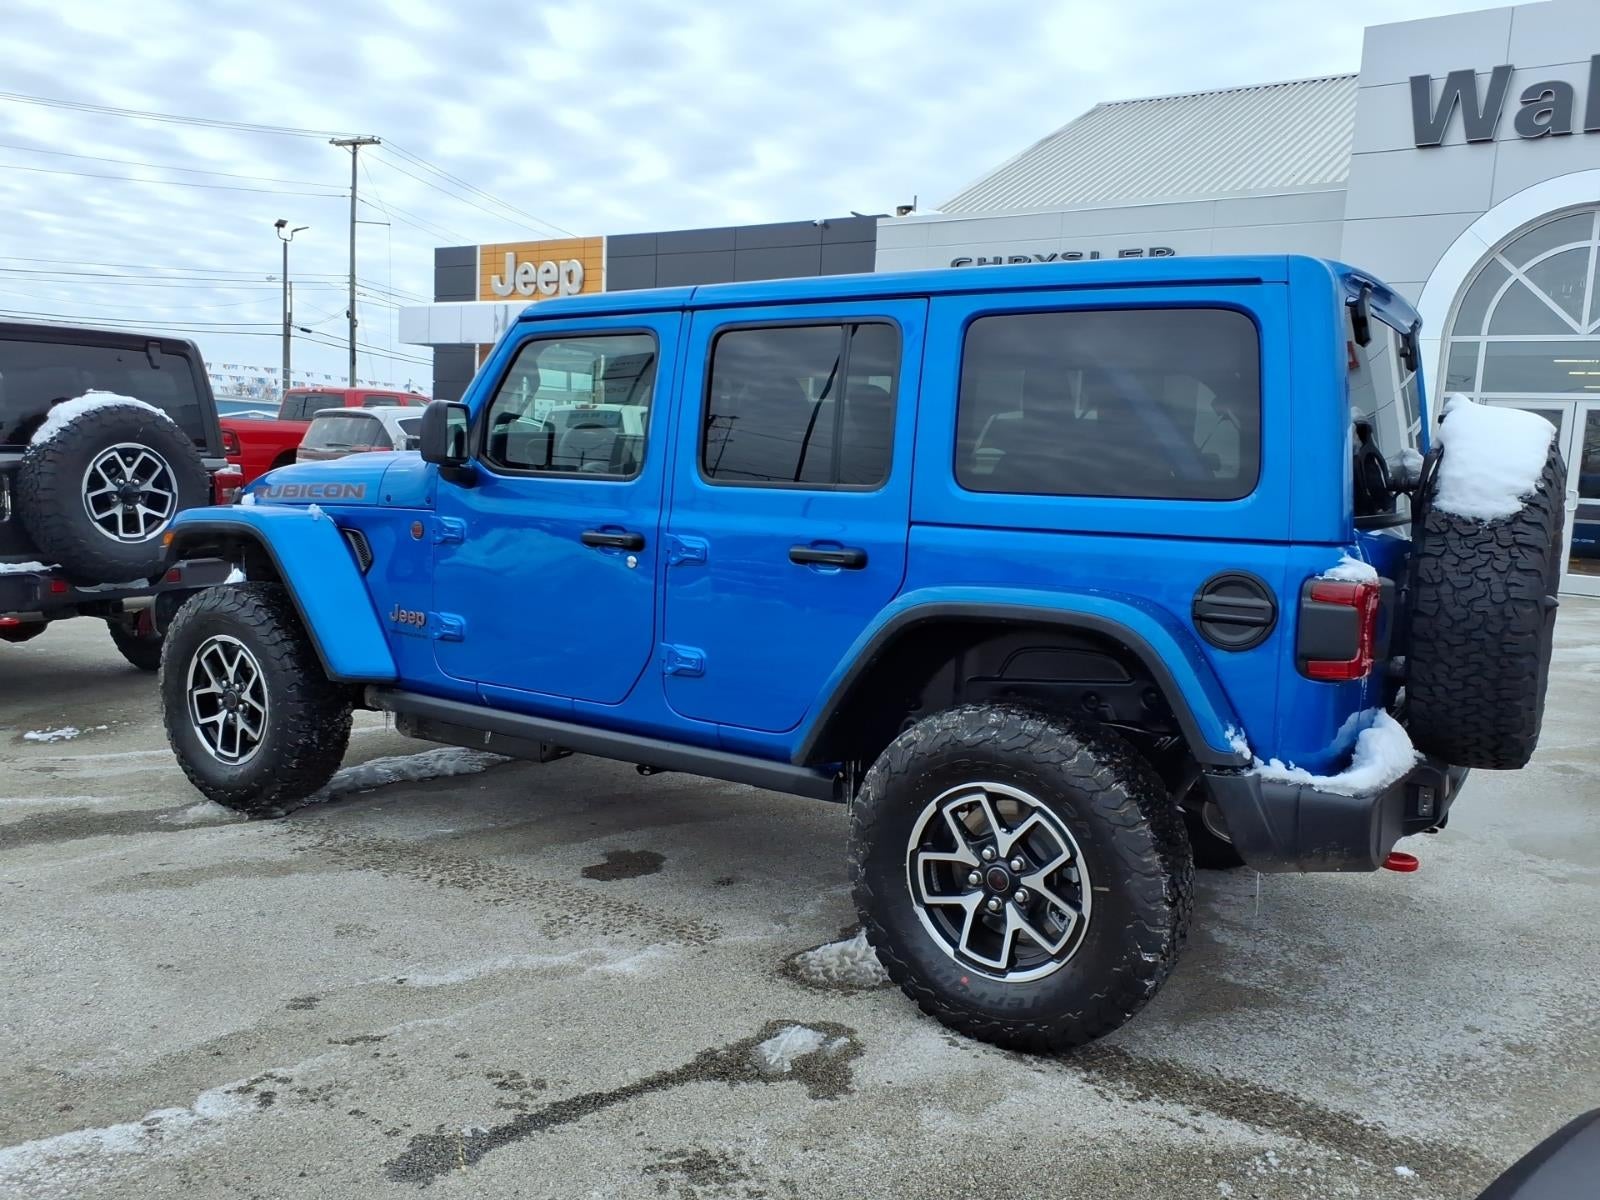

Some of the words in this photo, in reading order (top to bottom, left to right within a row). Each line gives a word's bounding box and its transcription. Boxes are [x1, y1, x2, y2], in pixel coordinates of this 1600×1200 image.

[491, 251, 584, 297] Jeep
[255, 483, 366, 499] RUBICON
[389, 603, 426, 628] Jeep
